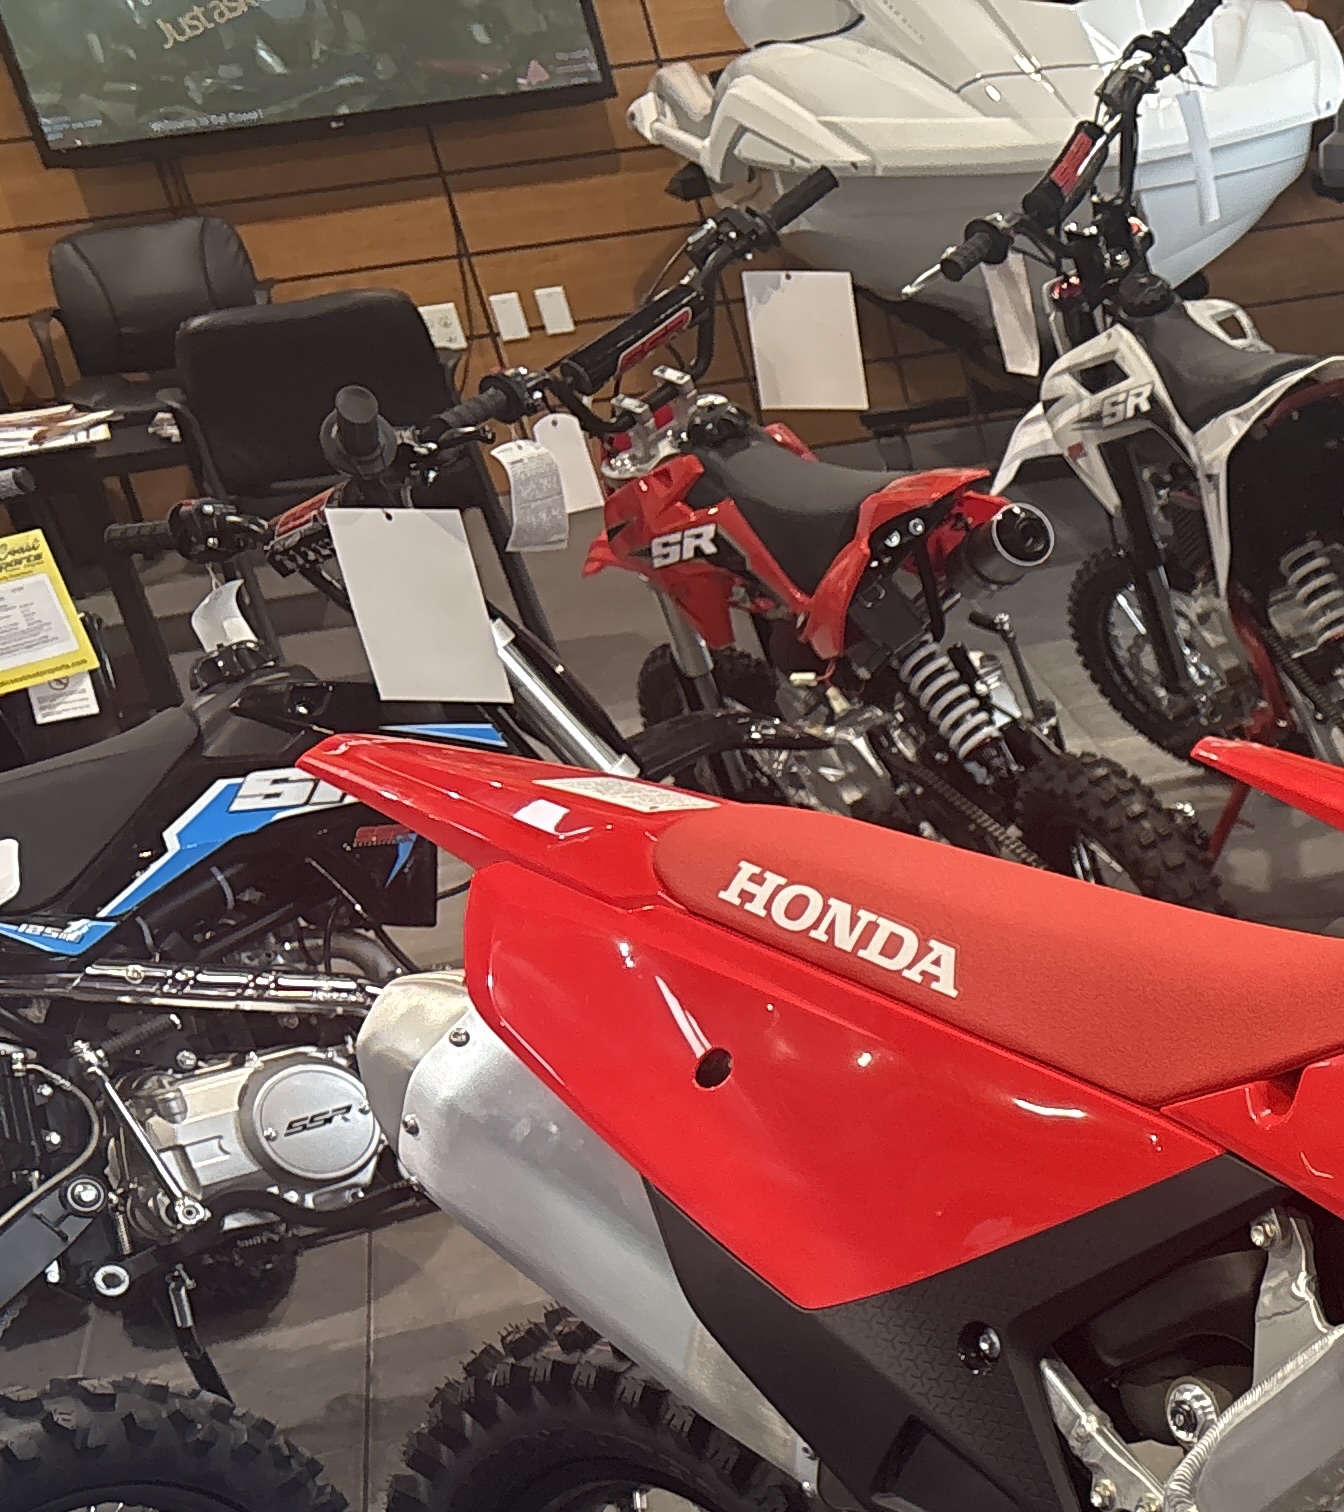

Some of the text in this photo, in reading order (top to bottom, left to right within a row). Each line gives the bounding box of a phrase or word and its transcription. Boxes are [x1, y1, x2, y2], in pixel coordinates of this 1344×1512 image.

[156, 4, 215, 49] Just
[1100, 383, 1153, 427] SR
[651, 523, 718, 569] SR
[717, 860, 959, 998] HONDA
[284, 1104, 353, 1137] SSR
